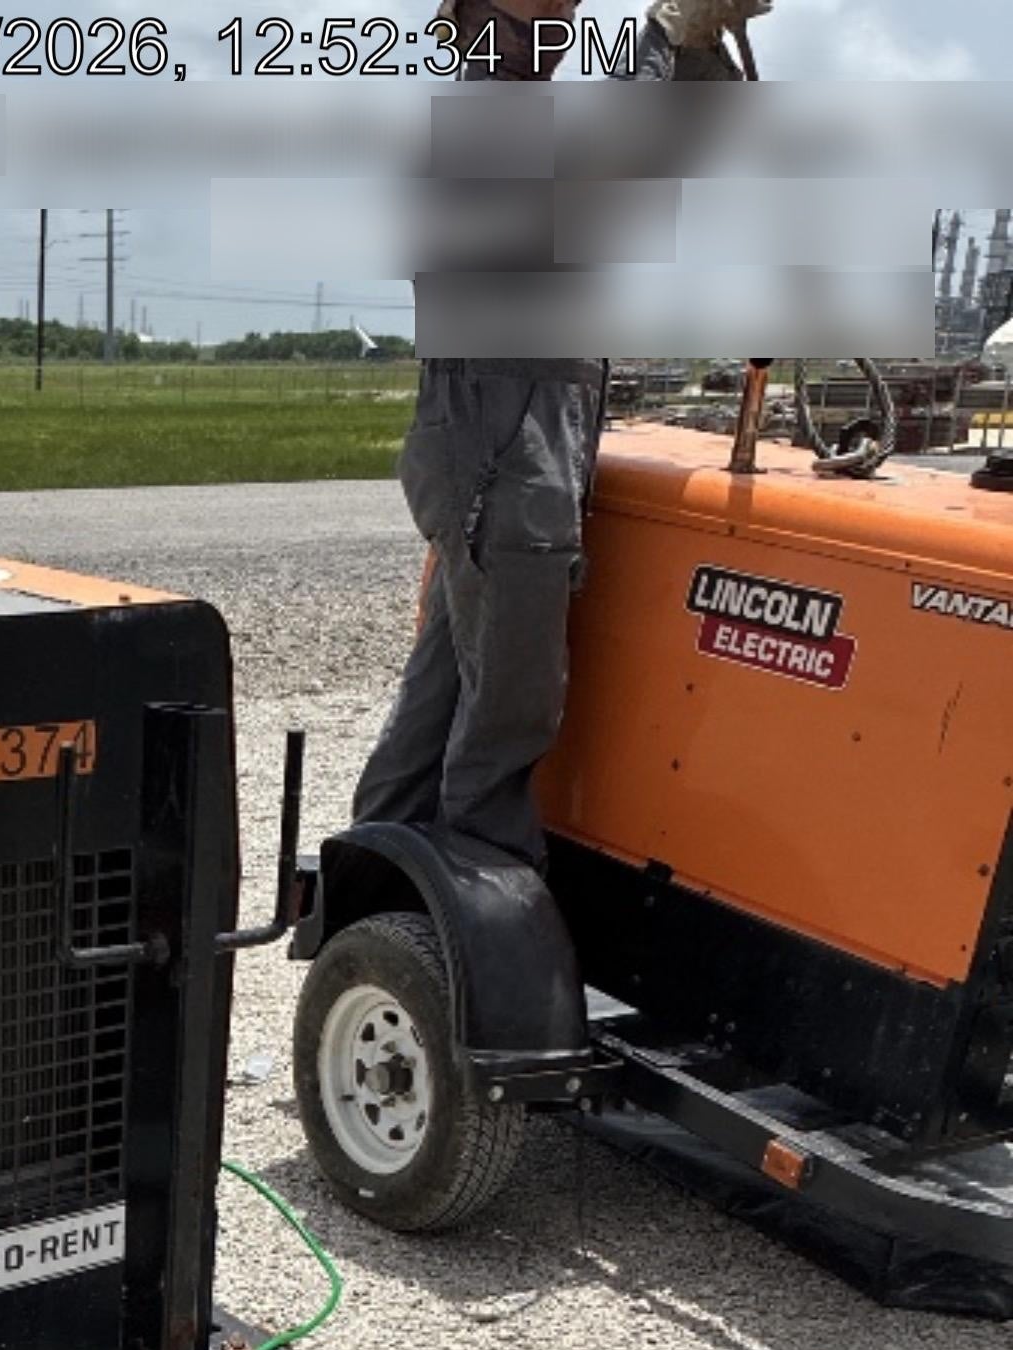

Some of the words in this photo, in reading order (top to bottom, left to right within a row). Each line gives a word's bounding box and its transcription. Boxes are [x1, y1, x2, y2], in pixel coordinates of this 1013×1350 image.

[694, 573, 833, 637] LINCOLN
[912, 583, 1013, 629] VANTA
[713, 623, 834, 678] ELECTRIC
